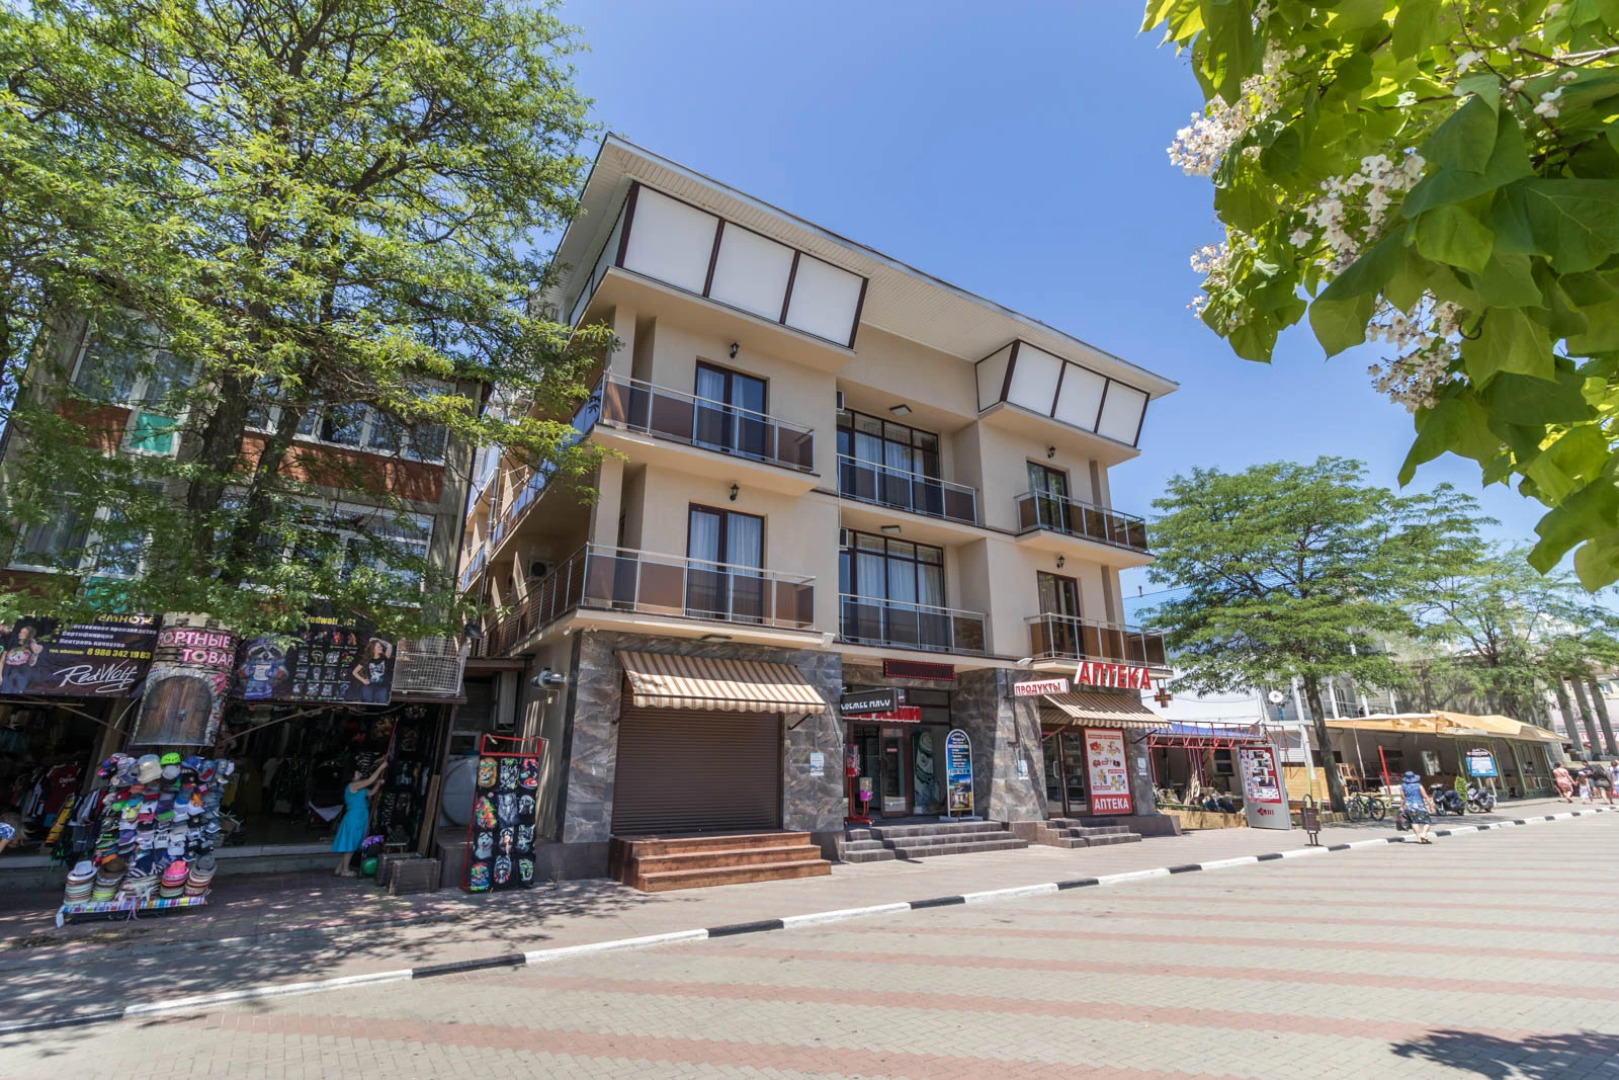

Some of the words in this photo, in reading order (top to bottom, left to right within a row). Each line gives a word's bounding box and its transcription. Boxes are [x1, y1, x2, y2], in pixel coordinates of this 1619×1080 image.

[62, 630, 114, 639] Сертификация
[58, 638, 93, 646] Контроль
[86, 647, 94, 656] 8
[112, 649, 129, 658] 342
[1074, 661, 1152, 690] АПТЕКА
[1015, 682, 1062, 695] ПРОДУКТЫ
[1094, 798, 1130, 811] АПТЕКА
